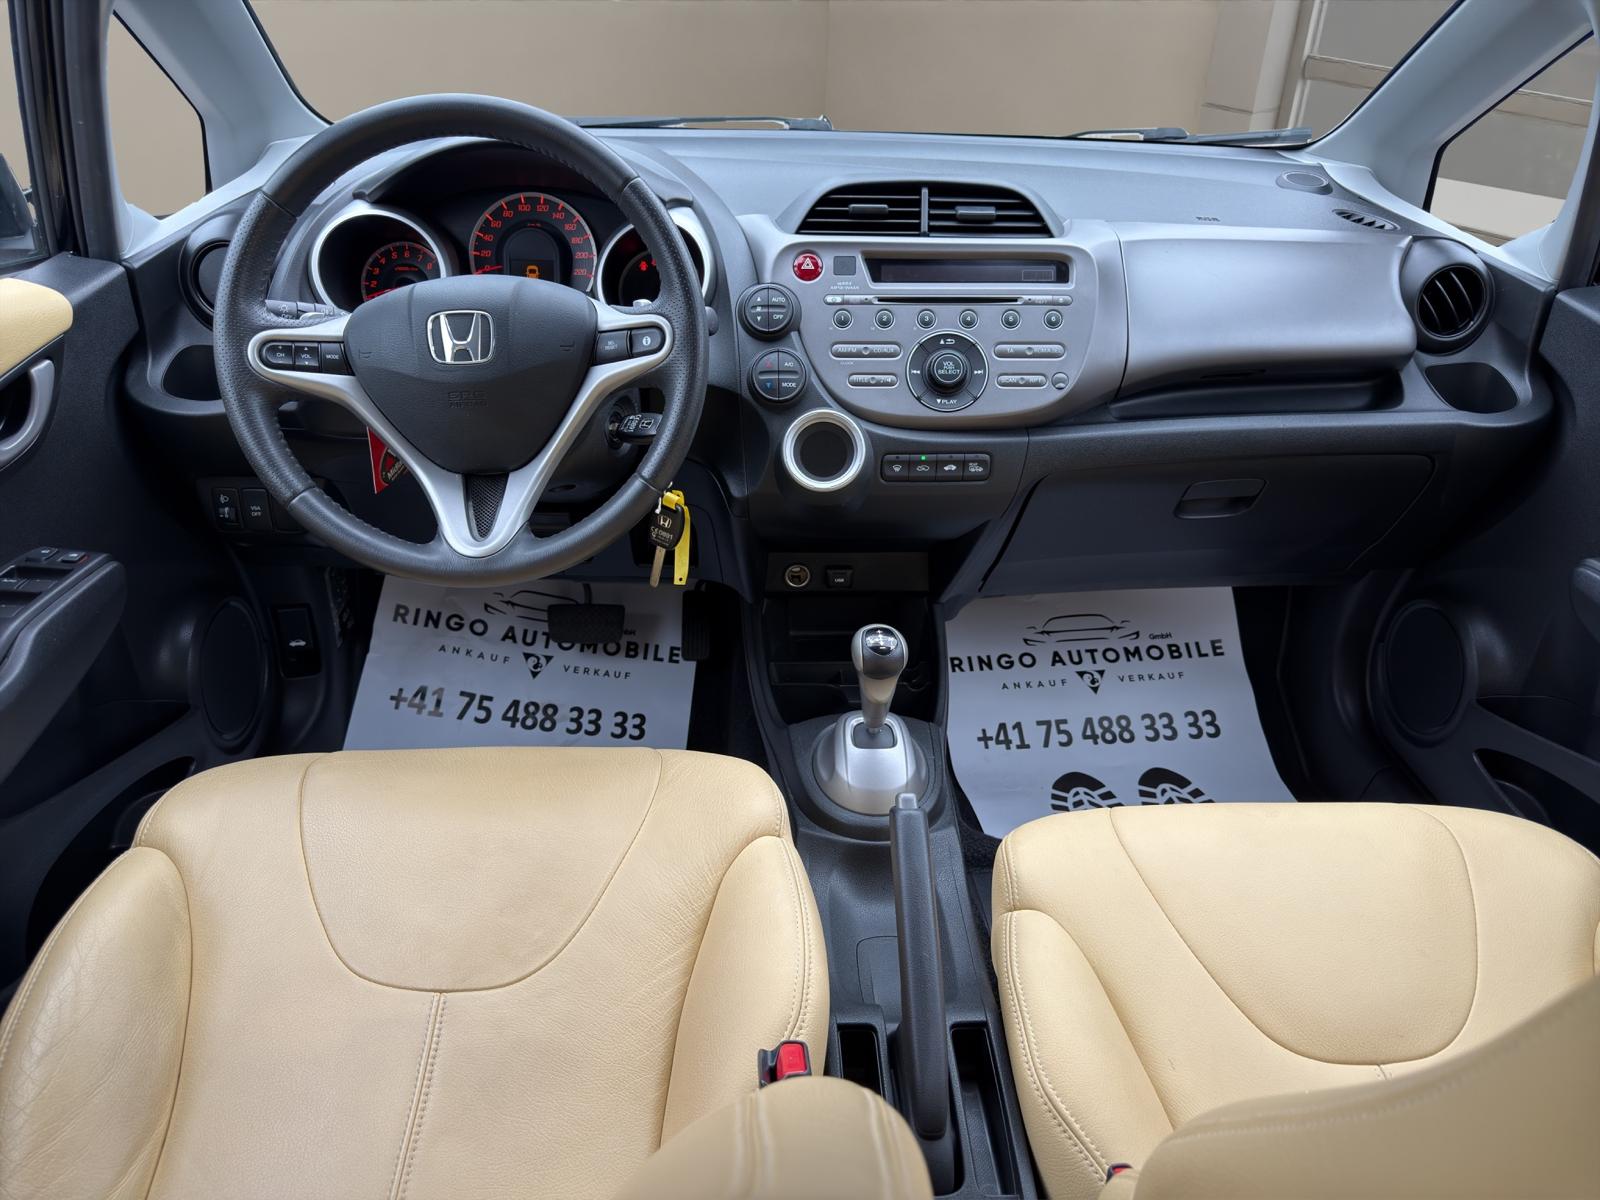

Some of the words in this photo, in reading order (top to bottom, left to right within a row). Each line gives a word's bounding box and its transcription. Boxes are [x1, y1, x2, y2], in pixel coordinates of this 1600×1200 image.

[518, 204, 531, 212] 100
[536, 204, 549, 212] 120
[502, 210, 514, 218] 80
[552, 212, 565, 220] 140
[491, 221, 502, 229] 60
[564, 222, 577, 231] 160
[483, 234, 494, 242] 40
[391, 252, 398, 260] 5
[404, 250, 410, 258] 6
[480, 249, 491, 257] 20
[379, 257, 386, 265] 4
[417, 254, 423, 262] 7
[573, 268, 587, 276] 220
[392, 604, 489, 637] RINGO
[1148, 632, 1172, 640] GmbH
[949, 652, 1037, 673] RINGO
[1050, 639, 1225, 667] AUTOMOBILE
[438, 644, 511, 665] ANKAUF
[563, 664, 632, 680] VERKAUF
[1001, 678, 1068, 691] ANKAUF
[1117, 671, 1185, 683] VERKAUF
[389, 685, 447, 718] +41
[456, 690, 494, 724] 75
[501, 699, 559, 732] 488
[565, 706, 602, 737] 33
[610, 710, 647, 741] 33
[977, 721, 1031, 751] +41
[1035, 719, 1073, 749] 75
[1081, 714, 1136, 745] 488
[1140, 712, 1178, 742] 33
[1184, 709, 1222, 740] 33
